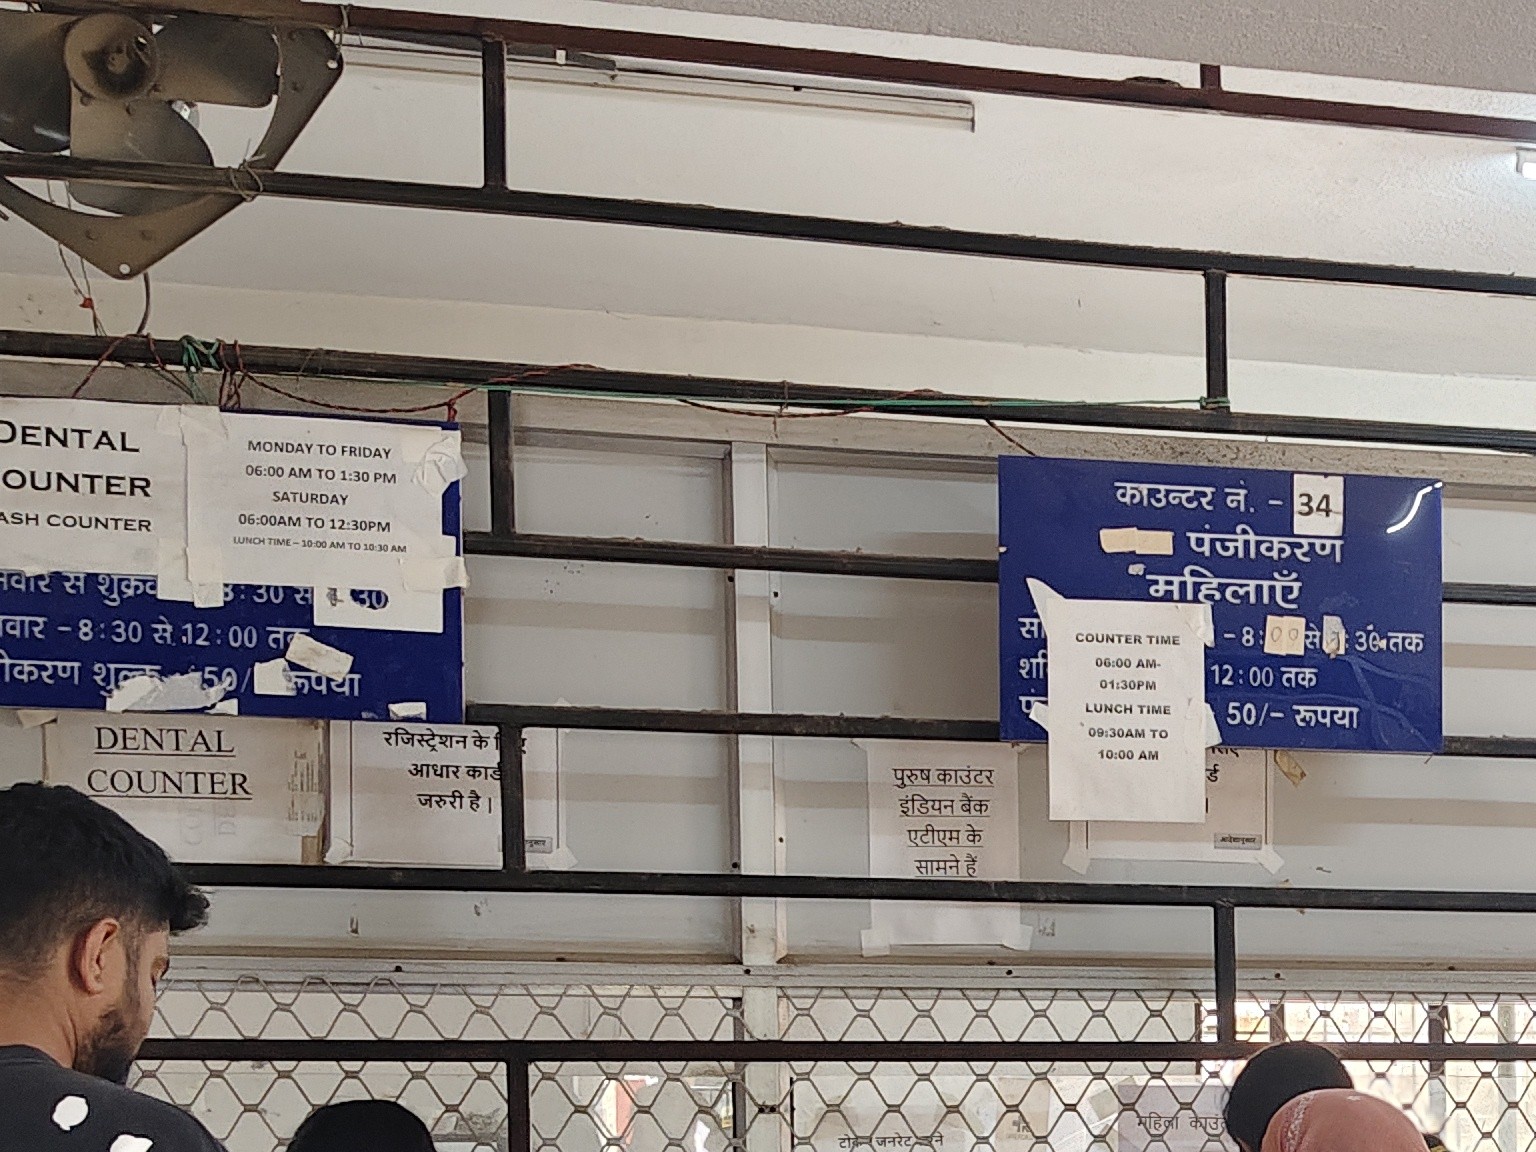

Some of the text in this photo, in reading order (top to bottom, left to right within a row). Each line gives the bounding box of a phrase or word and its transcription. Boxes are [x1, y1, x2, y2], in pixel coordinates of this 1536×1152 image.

[247, 440, 392, 459] MONDAY TO FRIDAY
[2, 469, 152, 498] OUNTER
[245, 464, 397, 485] 06:00 AM TO 1:30 PM
[272, 491, 349, 506] SATURDAY
[1114, 481, 1216, 512] काउन्टर
[1297, 493, 1333, 519] 34
[0, 511, 152, 532] ASH COUNTER
[238, 513, 391, 533] 06:00AM TO 12:30PM
[233, 536, 265, 546] LUNCH
[267, 538, 291, 547] TIME
[301, 539, 328, 550] 10:00
[329, 541, 345, 551] AM
[348, 542, 361, 552] TO
[363, 543, 388, 554] 10:30
[390, 545, 407, 554] AM
[1186, 523, 1344, 564] पंजीकरण
[1146, 565, 1303, 609] महिलाएँ
[78, 618, 142, 643] 8:30
[151, 616, 173, 645] से
[182, 622, 257, 648] 12:00
[1076, 632, 1181, 646] COUNTER TIME
[1388, 631, 1425, 653] तक
[1095, 657, 1132, 669] 06:00
[1099, 679, 1157, 691] 01:30PM
[1210, 664, 1319, 689] 12:00 तक
[1085, 703, 1172, 716] LUNCH TIME
[94, 726, 235, 753] DENTAL
[382, 727, 468, 752] रजिस्ट्रेशन
[471, 729, 491, 751] के
[1088, 728, 1169, 740] 09:30AM TO
[1098, 750, 1160, 762] 10:00 AM
[407, 761, 461, 780] आधार
[892, 765, 995, 789] पुरुष काउंटर
[87, 769, 252, 795] COUNTER
[898, 792, 991, 817] इंडियन बैंक
[907, 823, 984, 847] एटीएम के
[914, 854, 960, 876] सामने
[1135, 1111, 1180, 1131] महिला
[875, 1132, 912, 1147] जनरेट
